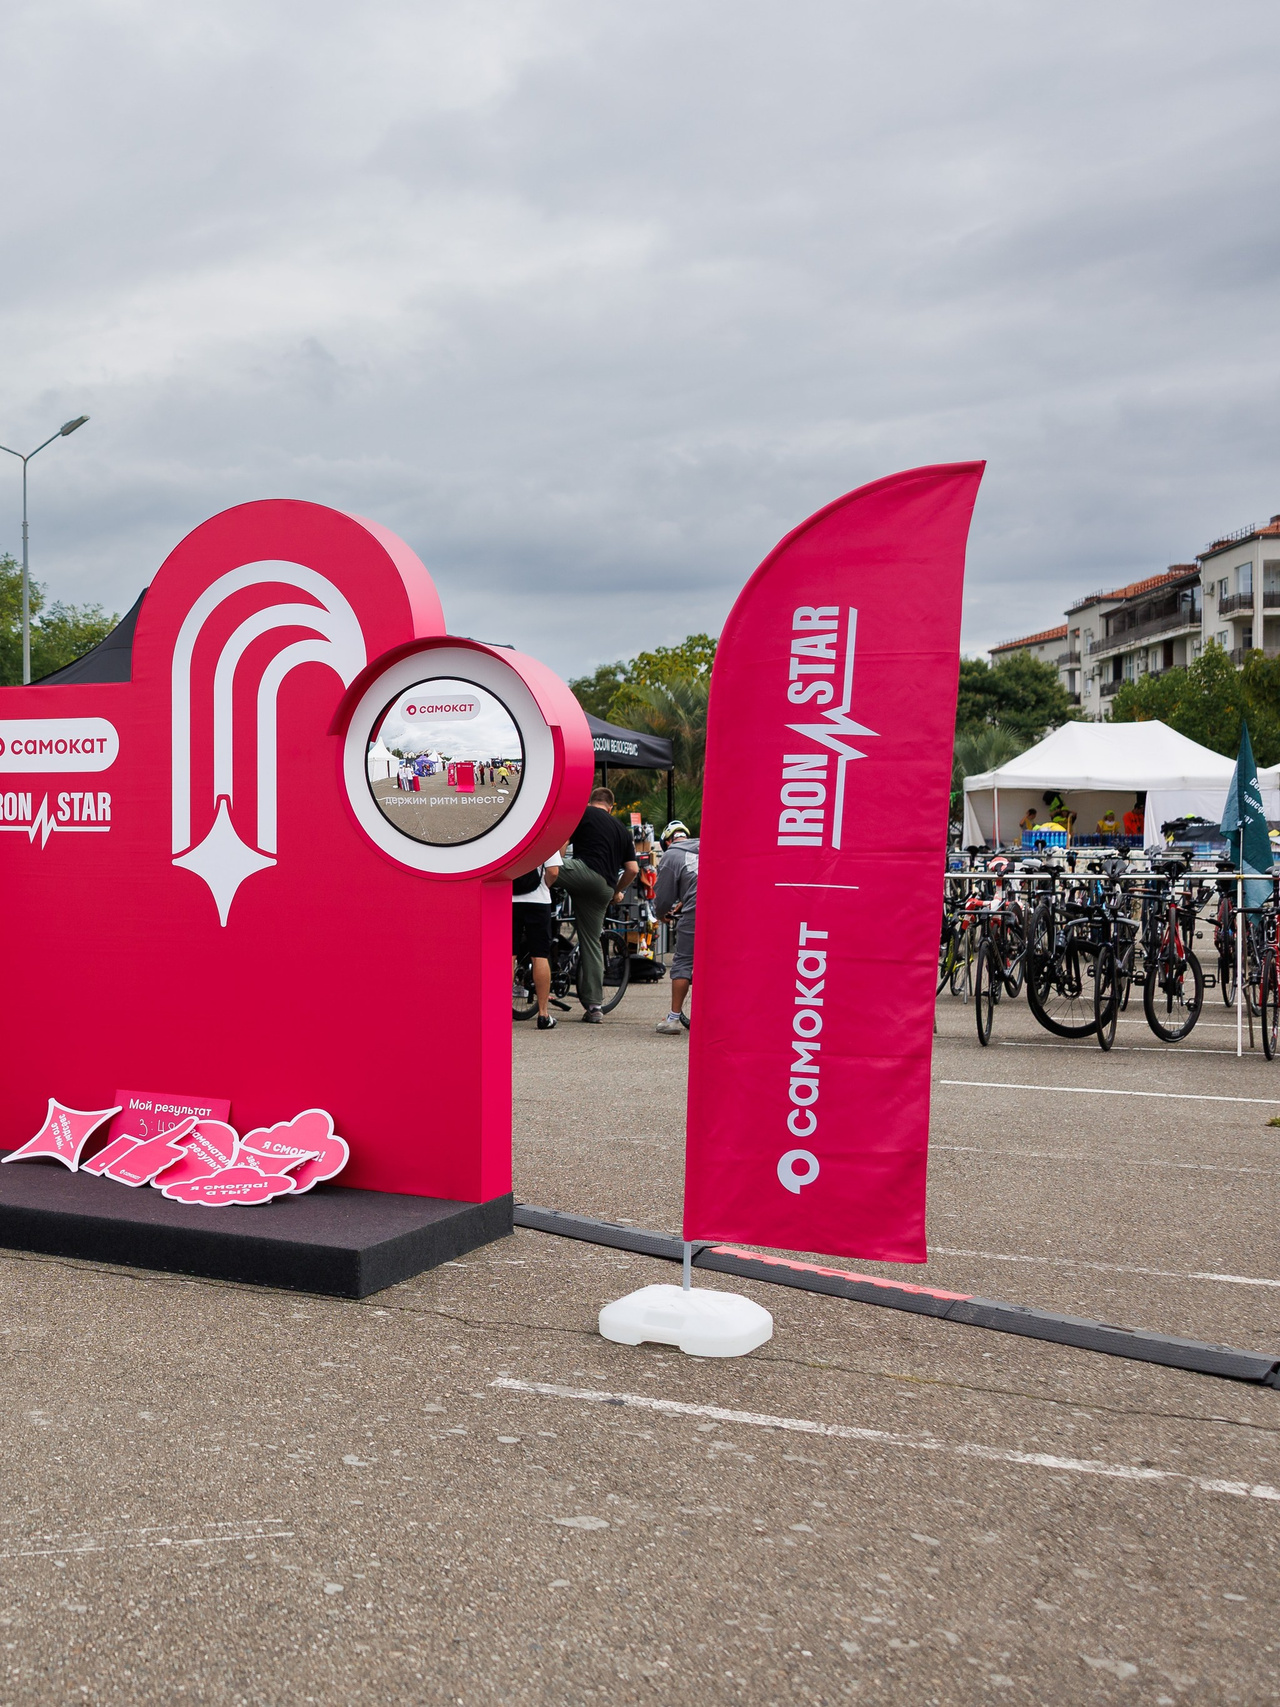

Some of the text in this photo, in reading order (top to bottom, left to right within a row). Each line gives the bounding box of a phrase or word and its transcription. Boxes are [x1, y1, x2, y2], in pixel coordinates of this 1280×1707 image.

[776, 605, 840, 848] IRON STAR
[593, 737, 610, 751] OSCOW
[57, 792, 112, 821] STAR
[385, 795, 505, 807] держим ритм вместе
[129, 1098, 212, 1117] Мой результат
[185, 1142, 222, 1170] результ
[189, 1128, 231, 1166] замечател
[272, 1143, 326, 1163] смог!
[203, 1182, 269, 1191] смогла!
